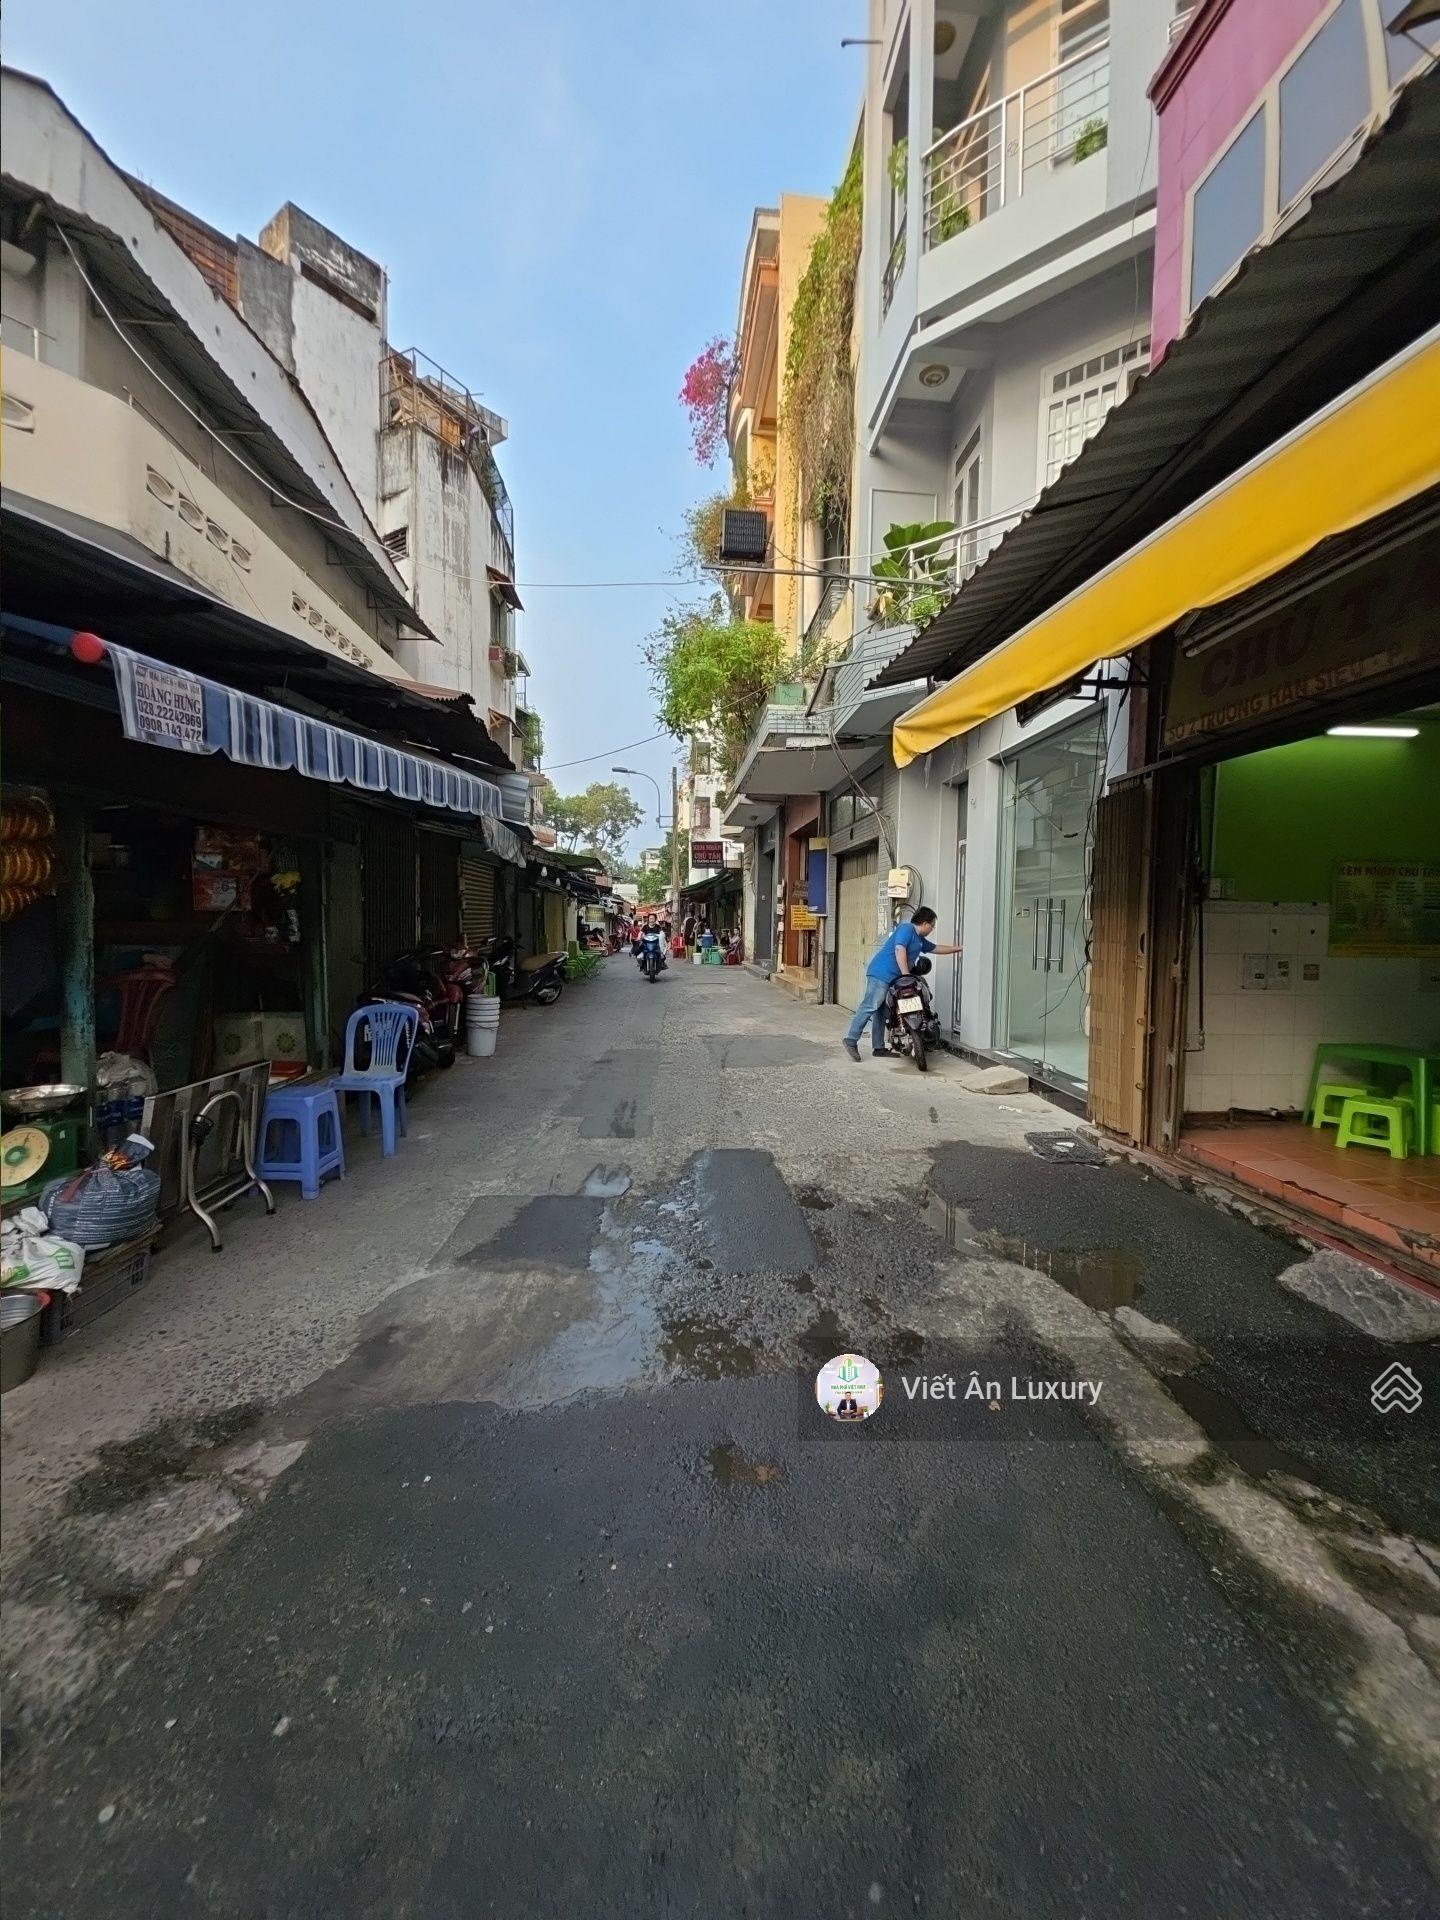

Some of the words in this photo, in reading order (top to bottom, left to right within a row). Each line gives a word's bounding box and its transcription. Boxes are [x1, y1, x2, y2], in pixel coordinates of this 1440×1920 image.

[137, 682, 172, 706] HOÀNG
[138, 699, 202, 728] 028.22242969
[139, 715, 202, 741] 0908.143.472
